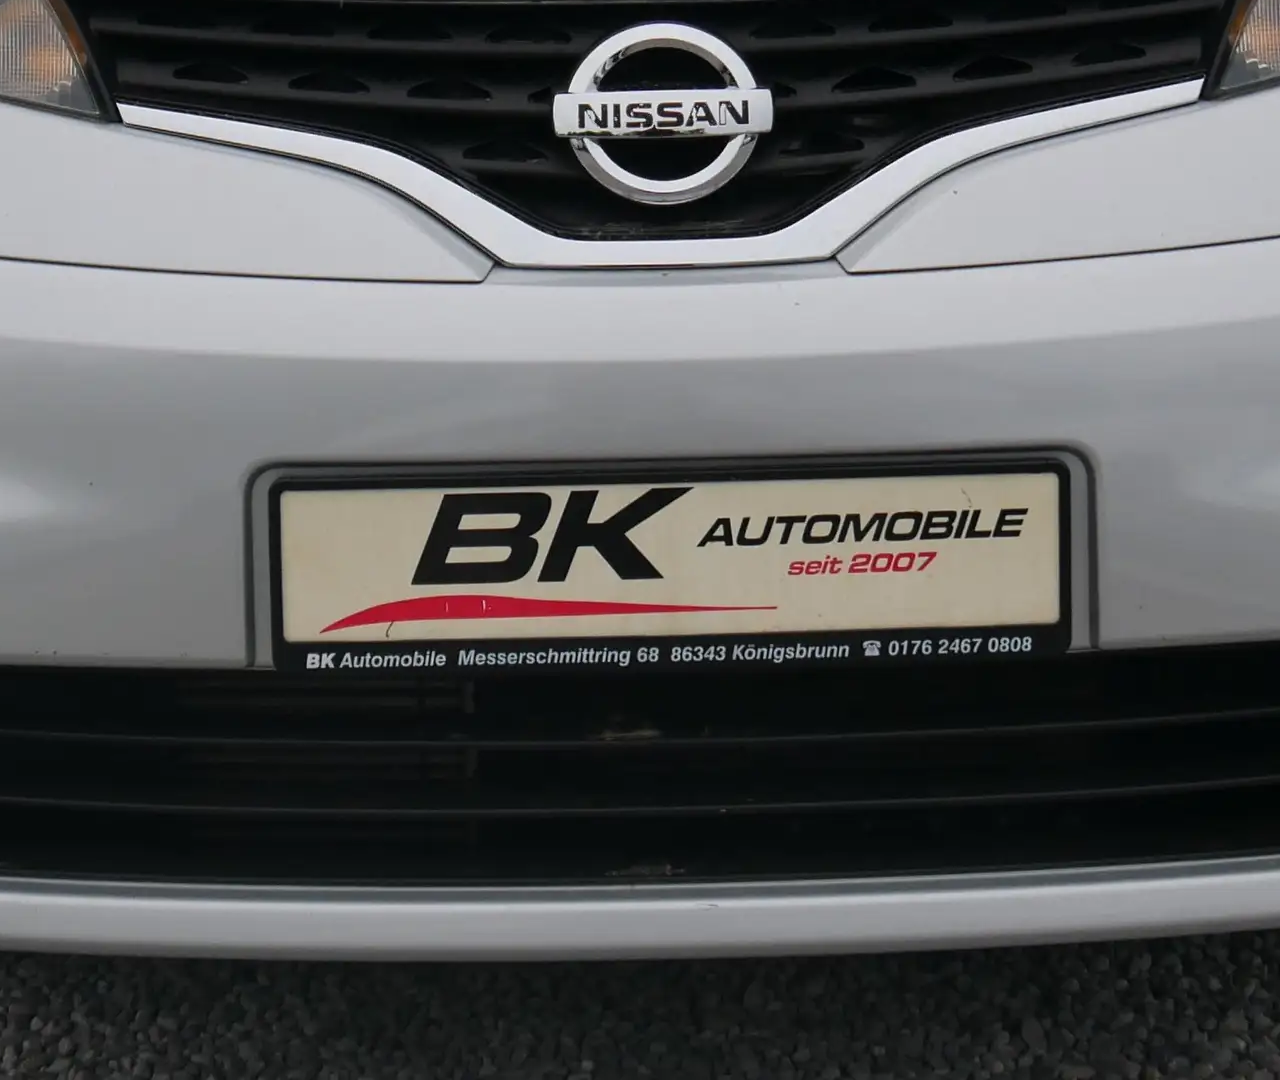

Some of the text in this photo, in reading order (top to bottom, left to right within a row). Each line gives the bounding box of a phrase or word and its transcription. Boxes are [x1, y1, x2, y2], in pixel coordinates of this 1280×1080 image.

[577, 99, 750, 129] NISSAN
[410, 486, 1029, 585] BK AUTOMOBILE
[787, 551, 938, 576] seit 2007
[306, 636, 1033, 669] BK Automobile Messerschmittring 68 86343 Königsbrunn 0176 2467 0808
